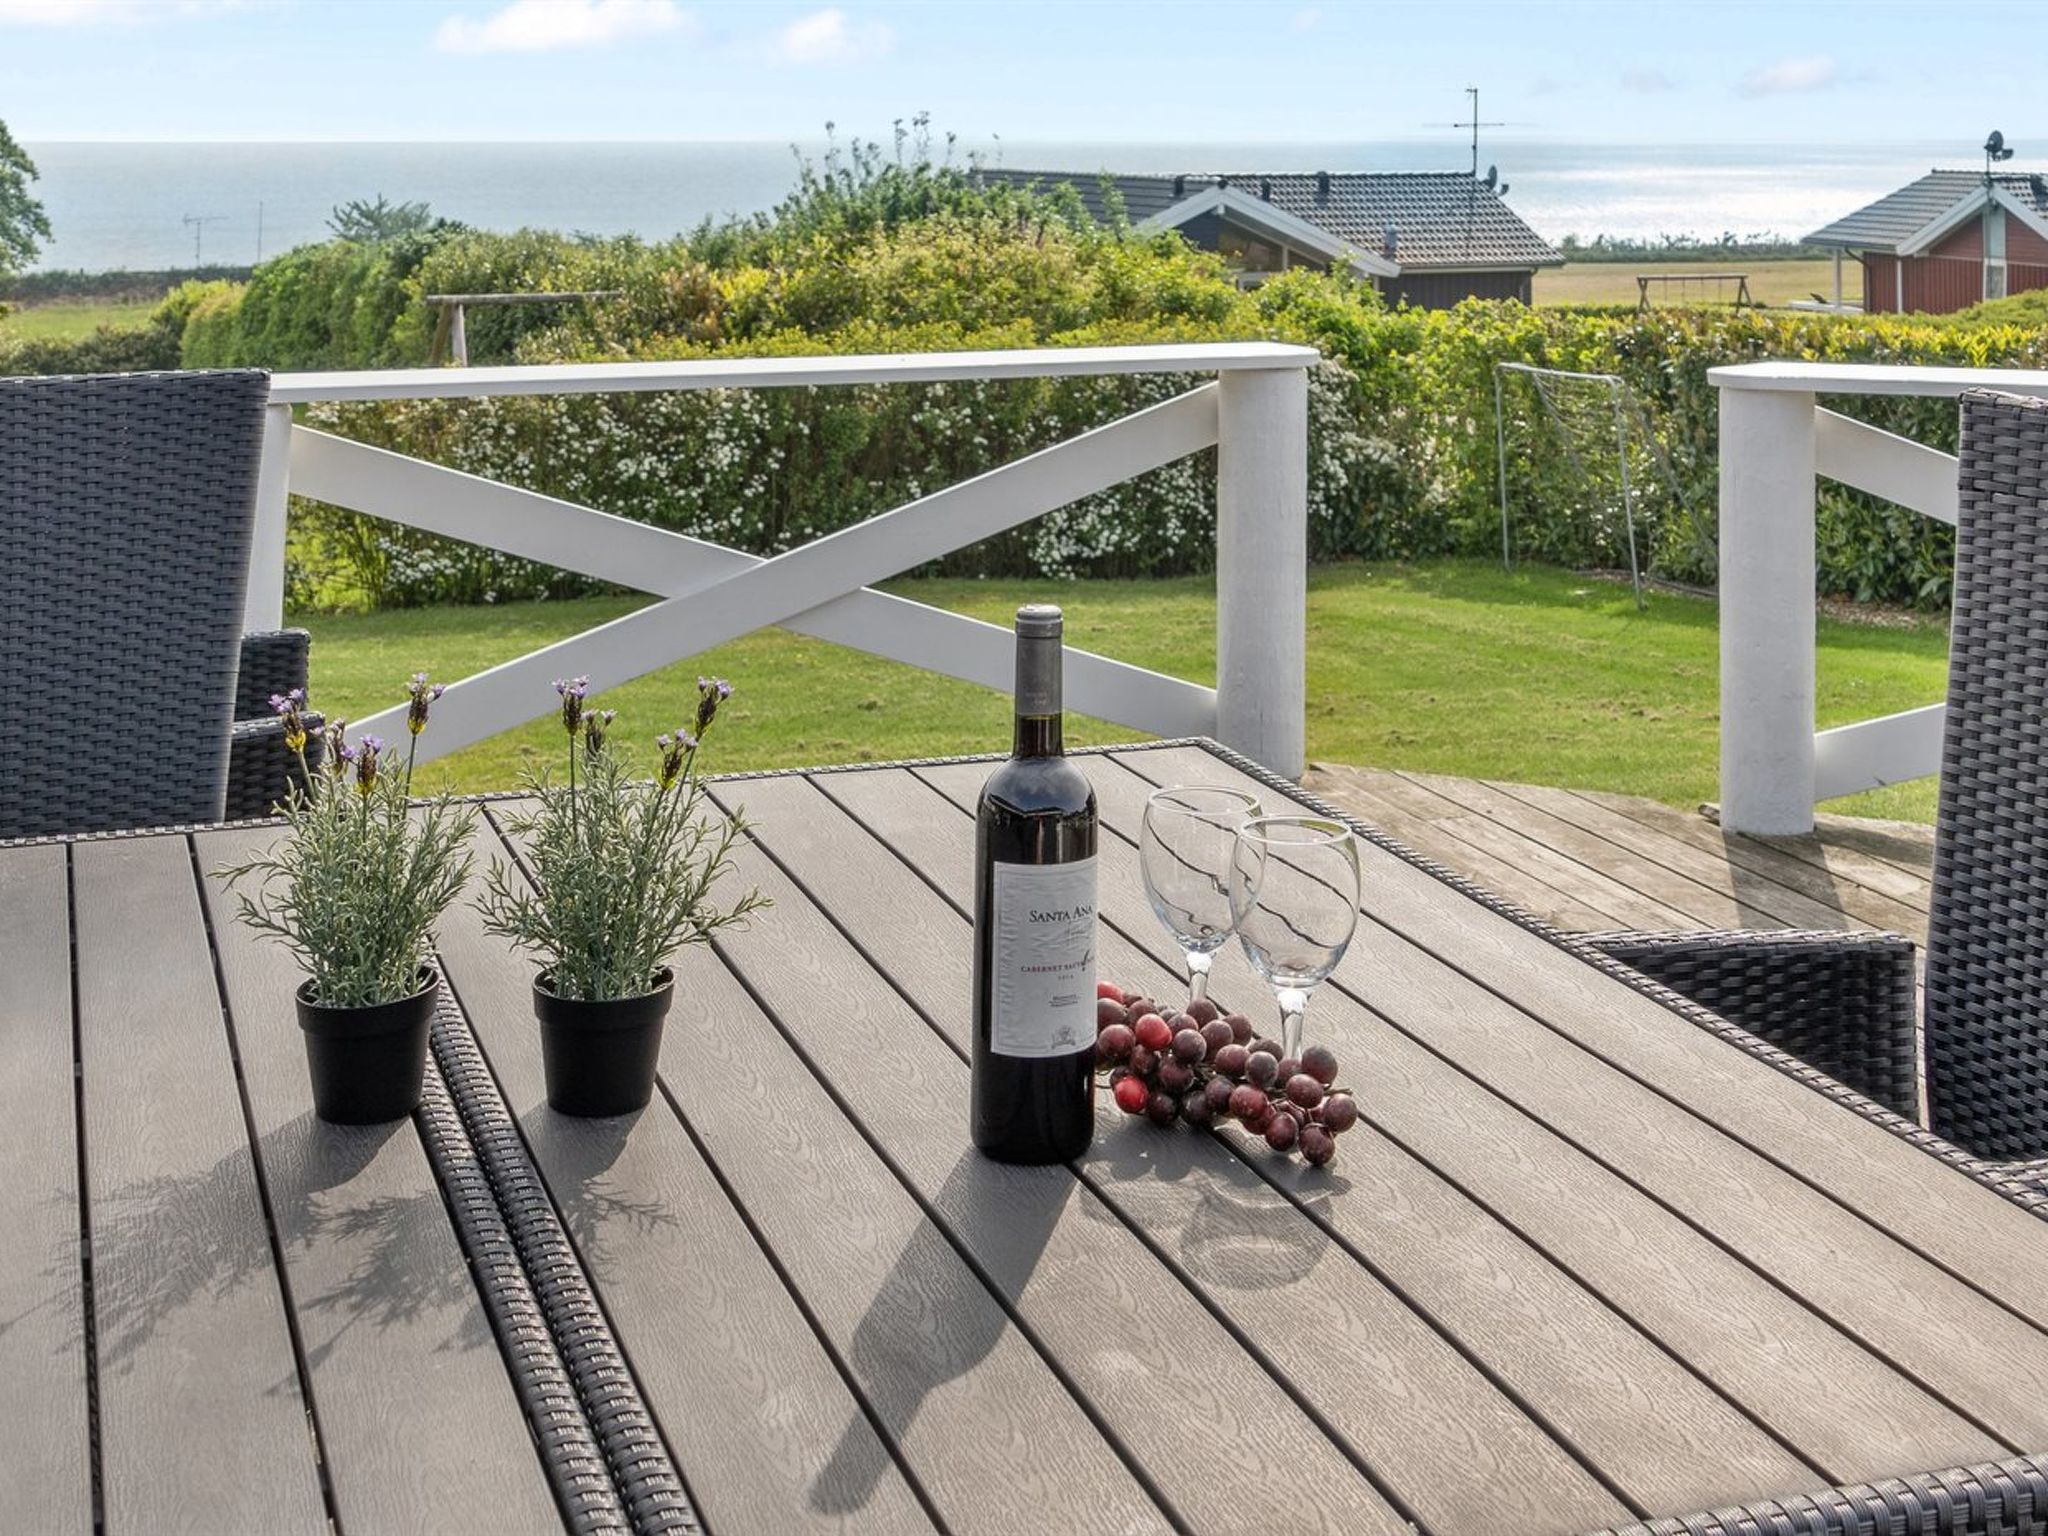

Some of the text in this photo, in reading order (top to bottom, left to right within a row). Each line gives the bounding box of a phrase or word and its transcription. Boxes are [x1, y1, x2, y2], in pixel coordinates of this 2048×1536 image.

[1029, 905, 1093, 923] SANTA ANA
[1020, 964, 1062, 973] CABERNET
